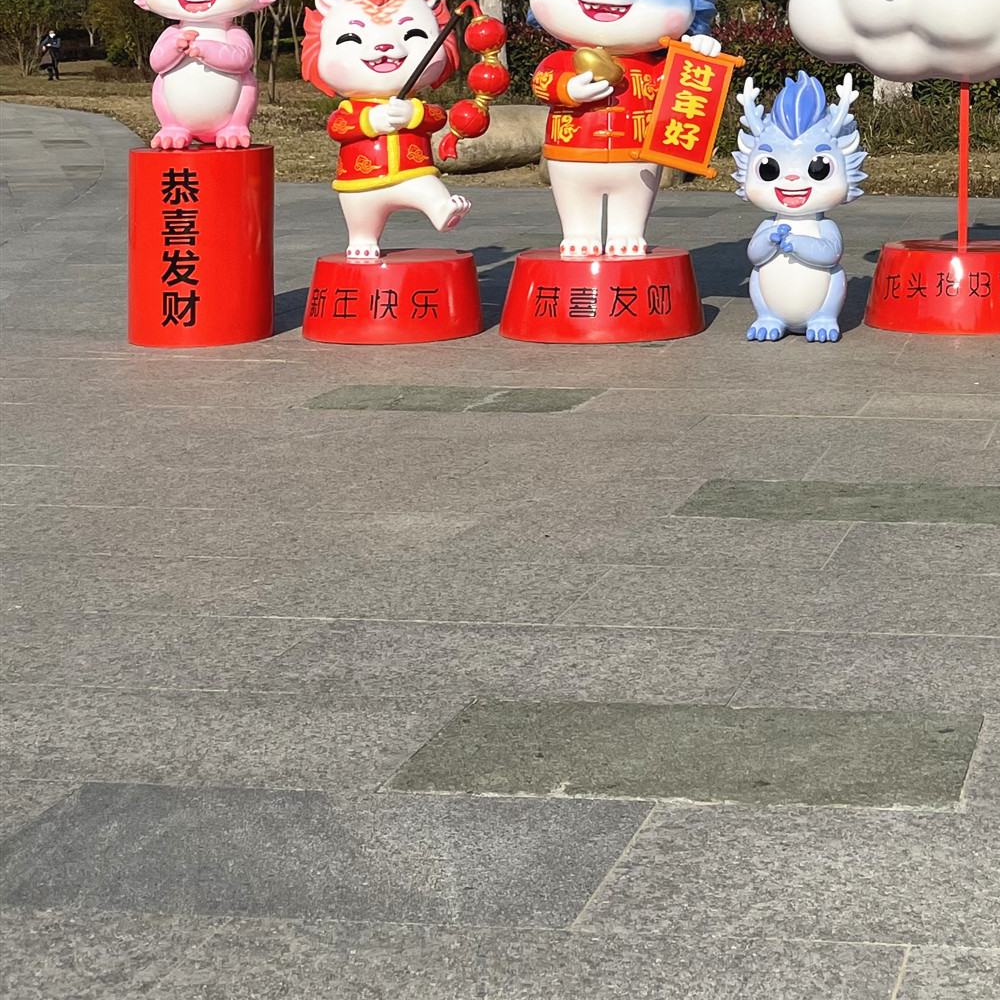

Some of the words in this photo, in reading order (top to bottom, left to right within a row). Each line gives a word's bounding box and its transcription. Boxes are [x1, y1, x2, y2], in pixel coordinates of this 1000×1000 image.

[662, 60, 716, 150] 过年好
[161, 168, 200, 327] 恭喜发财
[309, 288, 439, 319] 新年快乐
[535, 284, 672, 318] 恭喜发财
